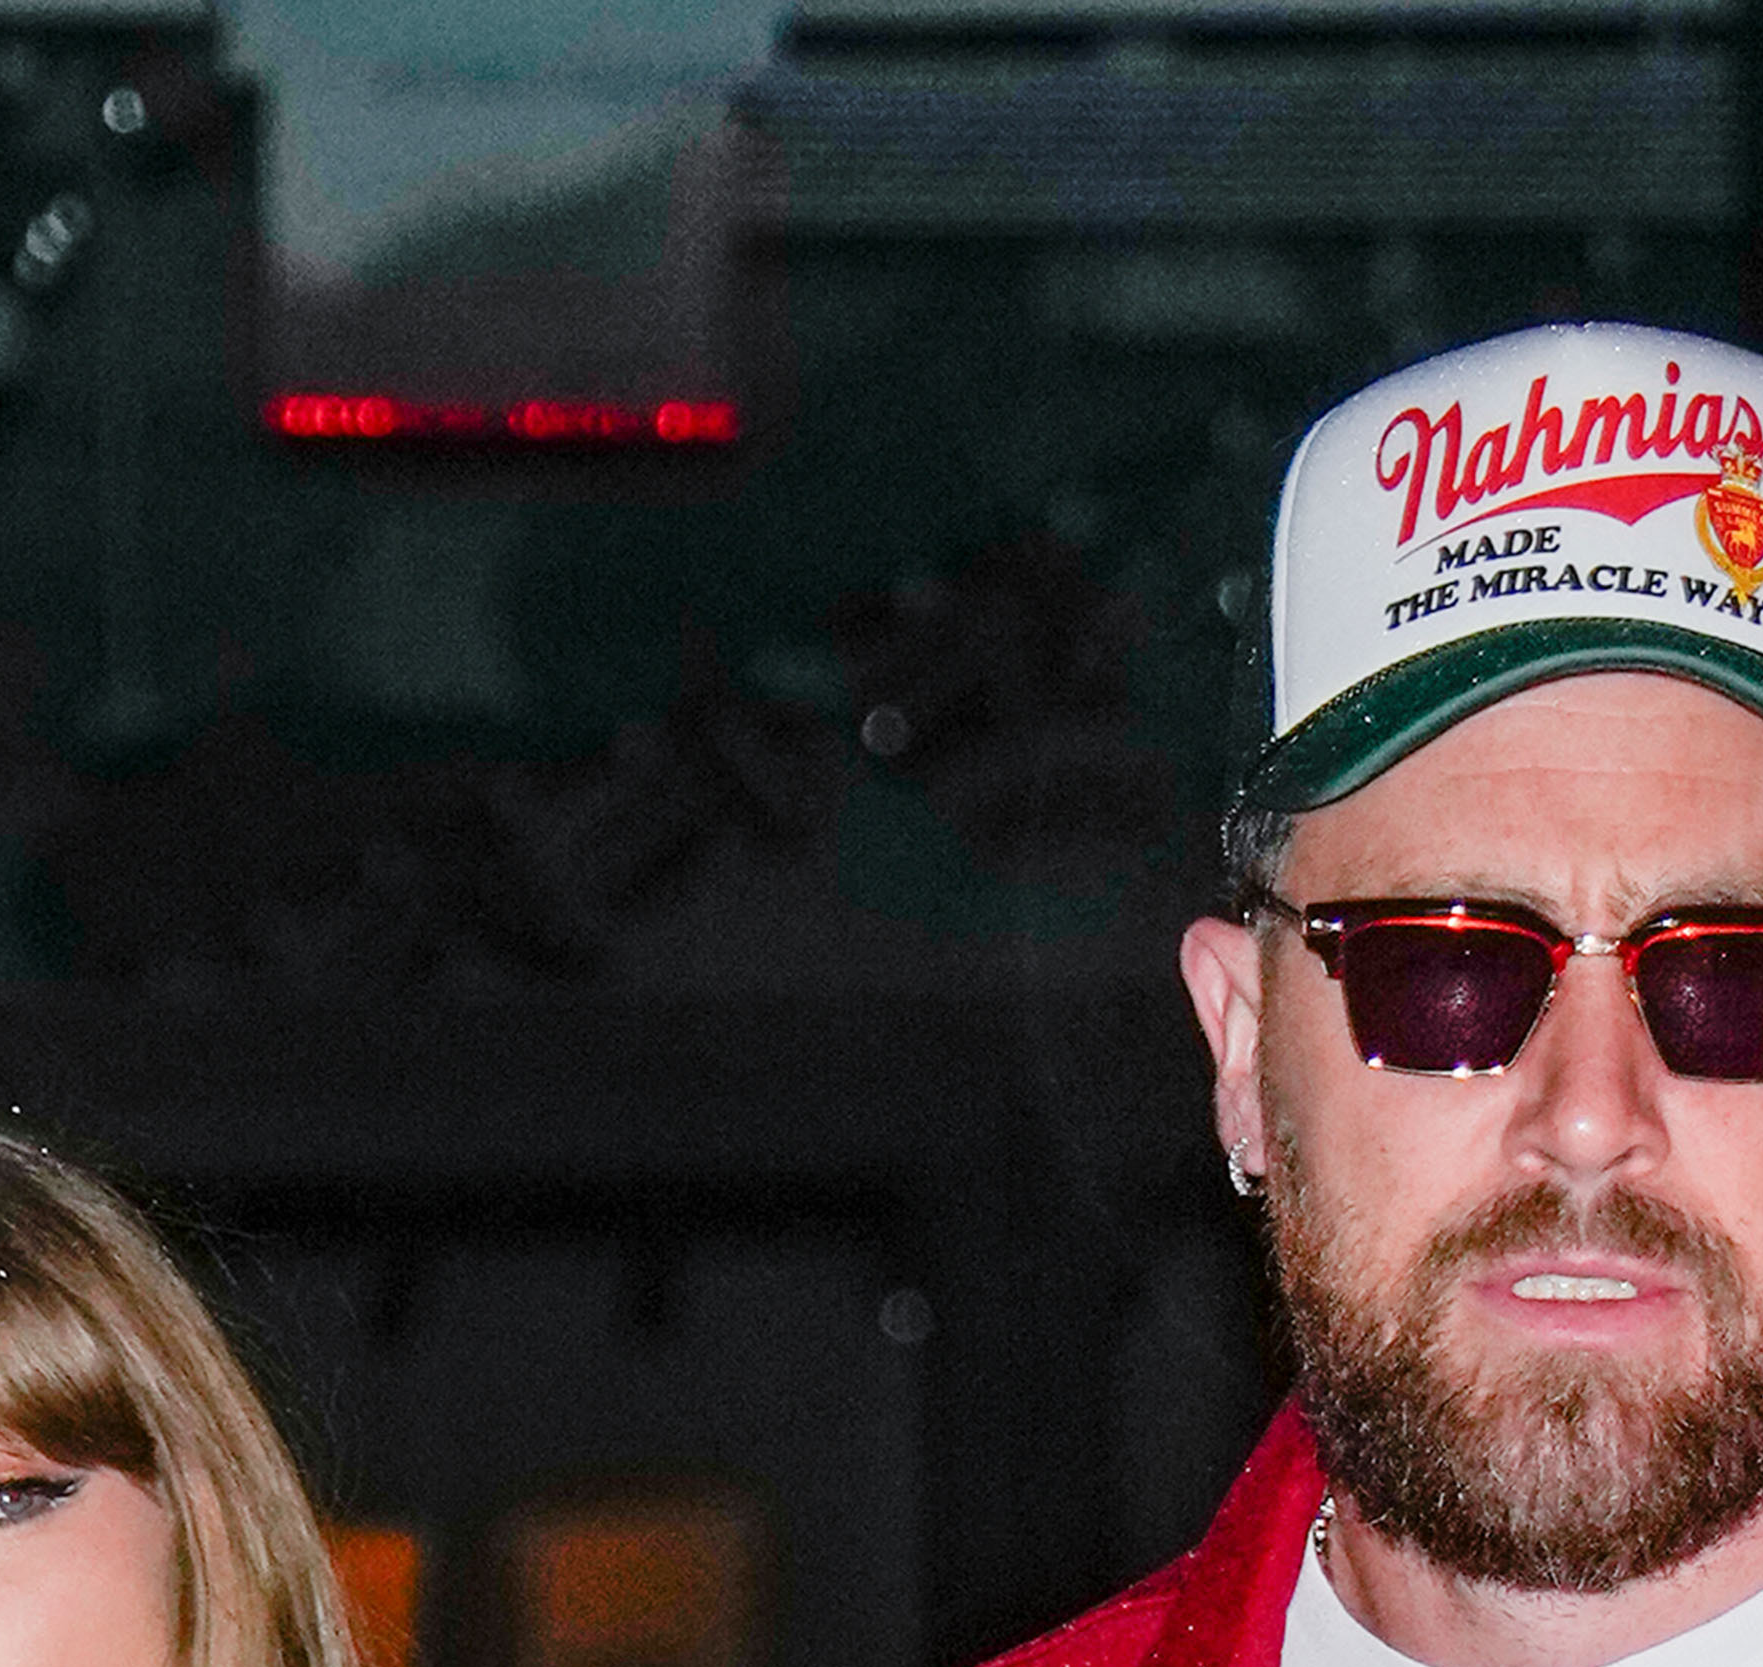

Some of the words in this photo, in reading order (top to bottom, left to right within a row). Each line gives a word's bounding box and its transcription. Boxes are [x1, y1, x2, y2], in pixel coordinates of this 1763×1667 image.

[1433, 526, 1562, 575] MADE
[1384, 579, 1460, 631] THE
[1467, 564, 1669, 603] MIRACLE
